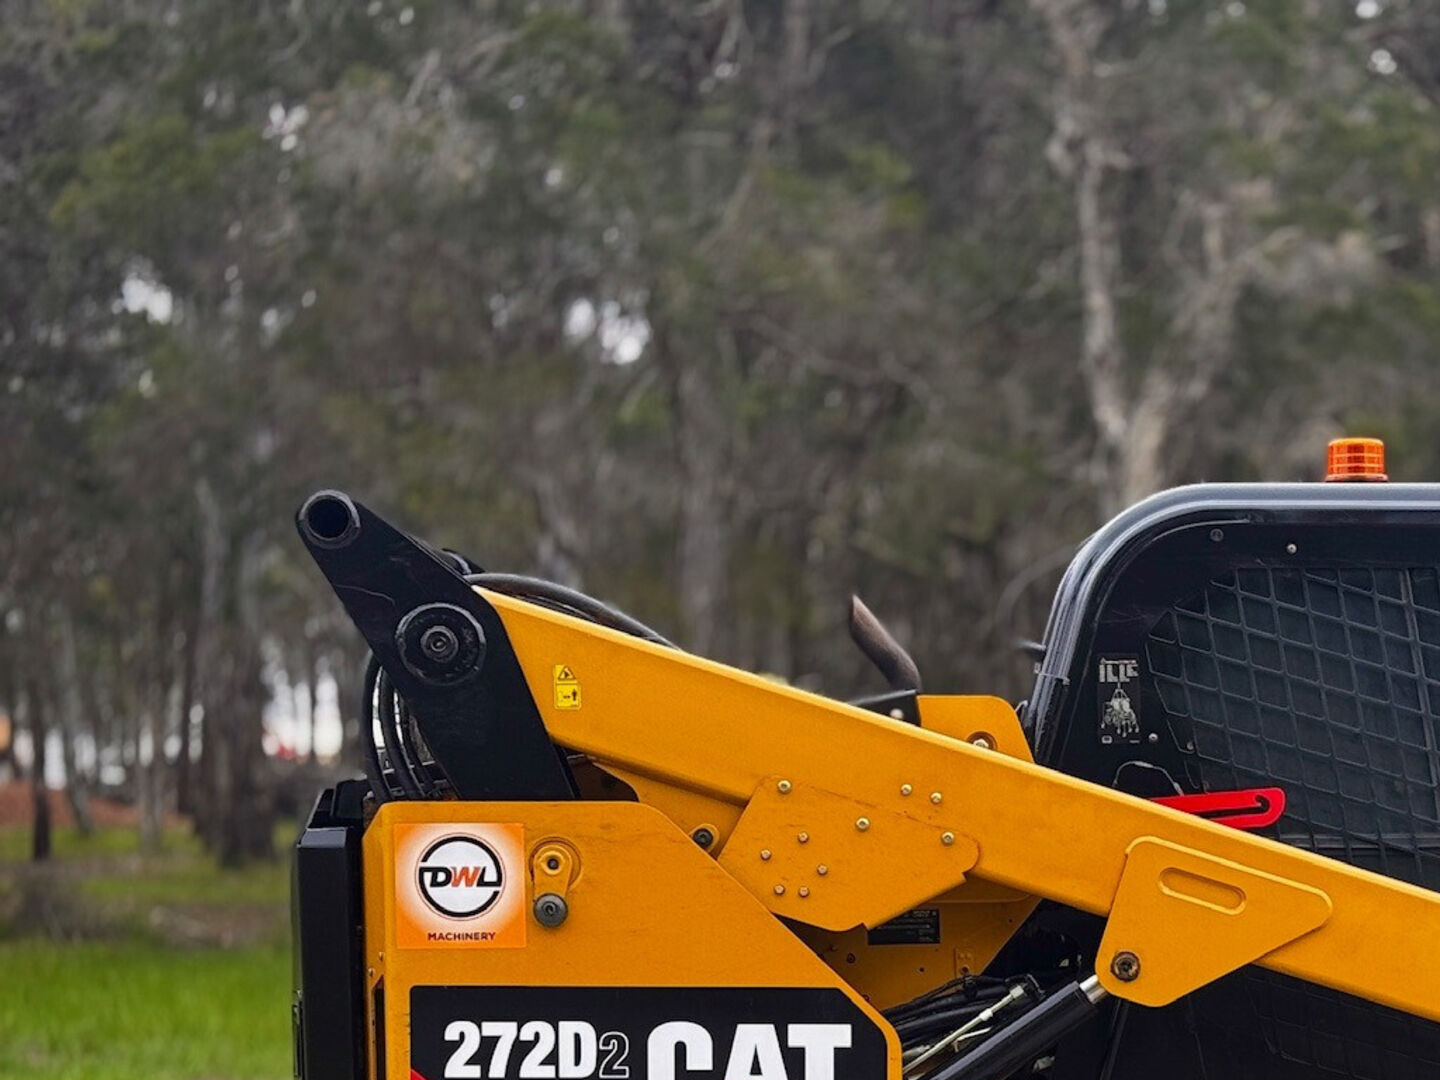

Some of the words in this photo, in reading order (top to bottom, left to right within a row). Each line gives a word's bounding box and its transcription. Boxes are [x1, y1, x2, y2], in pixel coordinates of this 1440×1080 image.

[419, 866, 502, 888] DWL
[427, 931, 497, 942] MACHINERY
[443, 1020, 630, 1079] 272D2
